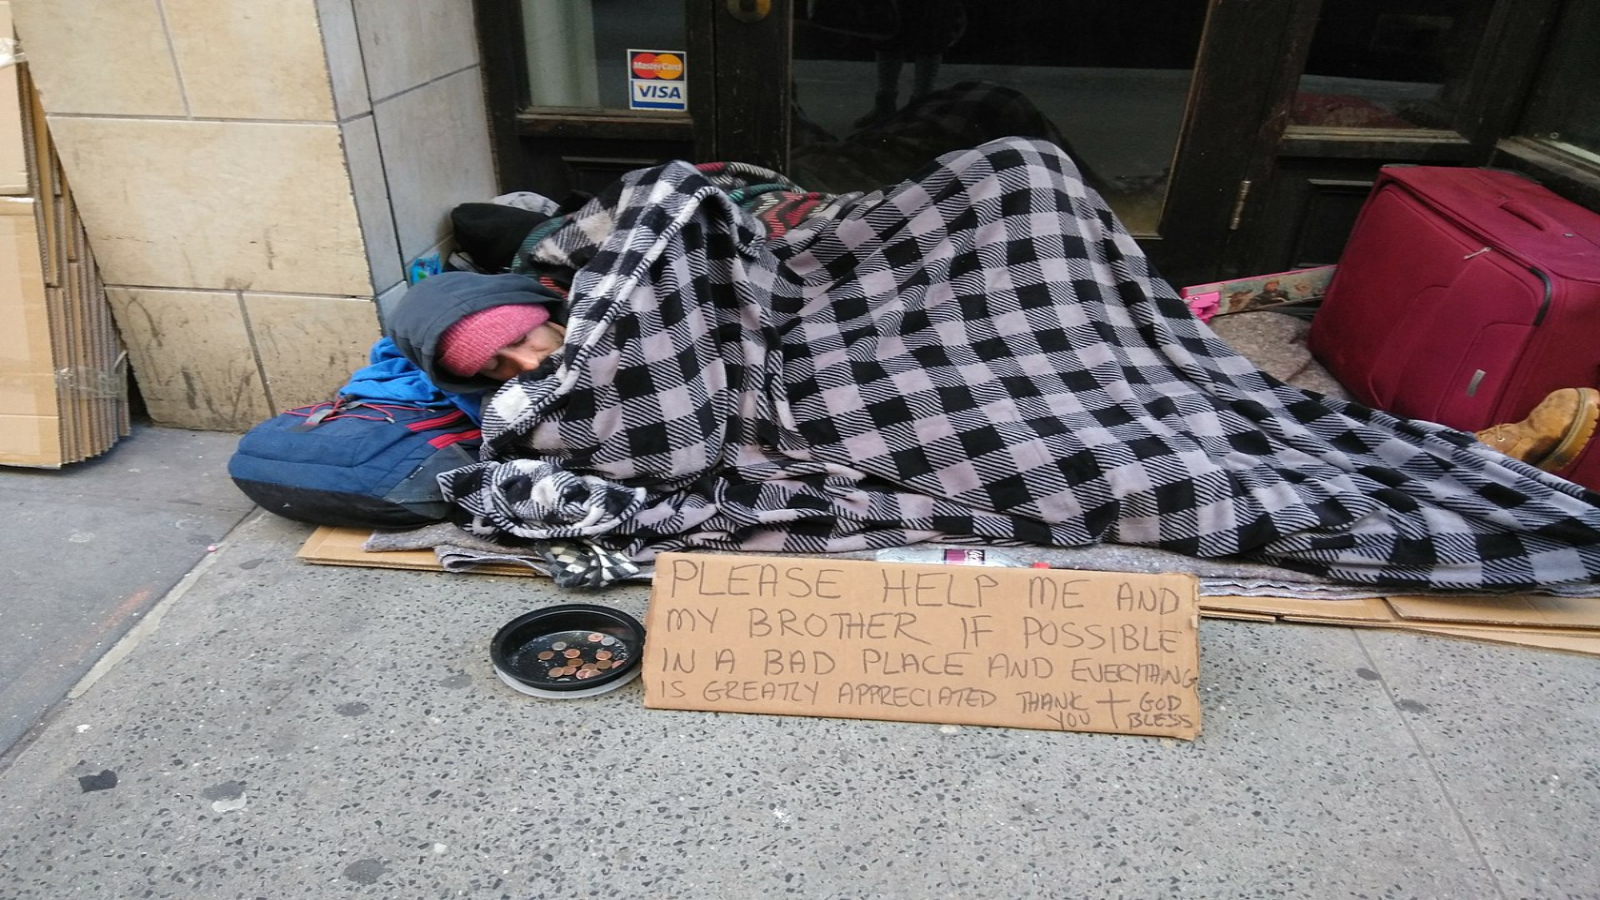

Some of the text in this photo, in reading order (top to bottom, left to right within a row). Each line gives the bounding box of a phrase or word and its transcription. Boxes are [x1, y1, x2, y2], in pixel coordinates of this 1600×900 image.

[637, 85, 681, 99] VISA
[671, 559, 1180, 615] PLEASE HELP ME AND
[666, 607, 1182, 653] MY BROTHER IF POSSIBLE
[662, 648, 696, 674] IN
[715, 648, 736, 675] A
[764, 650, 836, 676] BAD
[862, 648, 973, 676] PLACE
[988, 653, 1054, 679] AND
[661, 680, 1183, 714] IS GREATLY APPRECIATED THANK GOD
[1047, 711, 1194, 731] YOU BLESS
